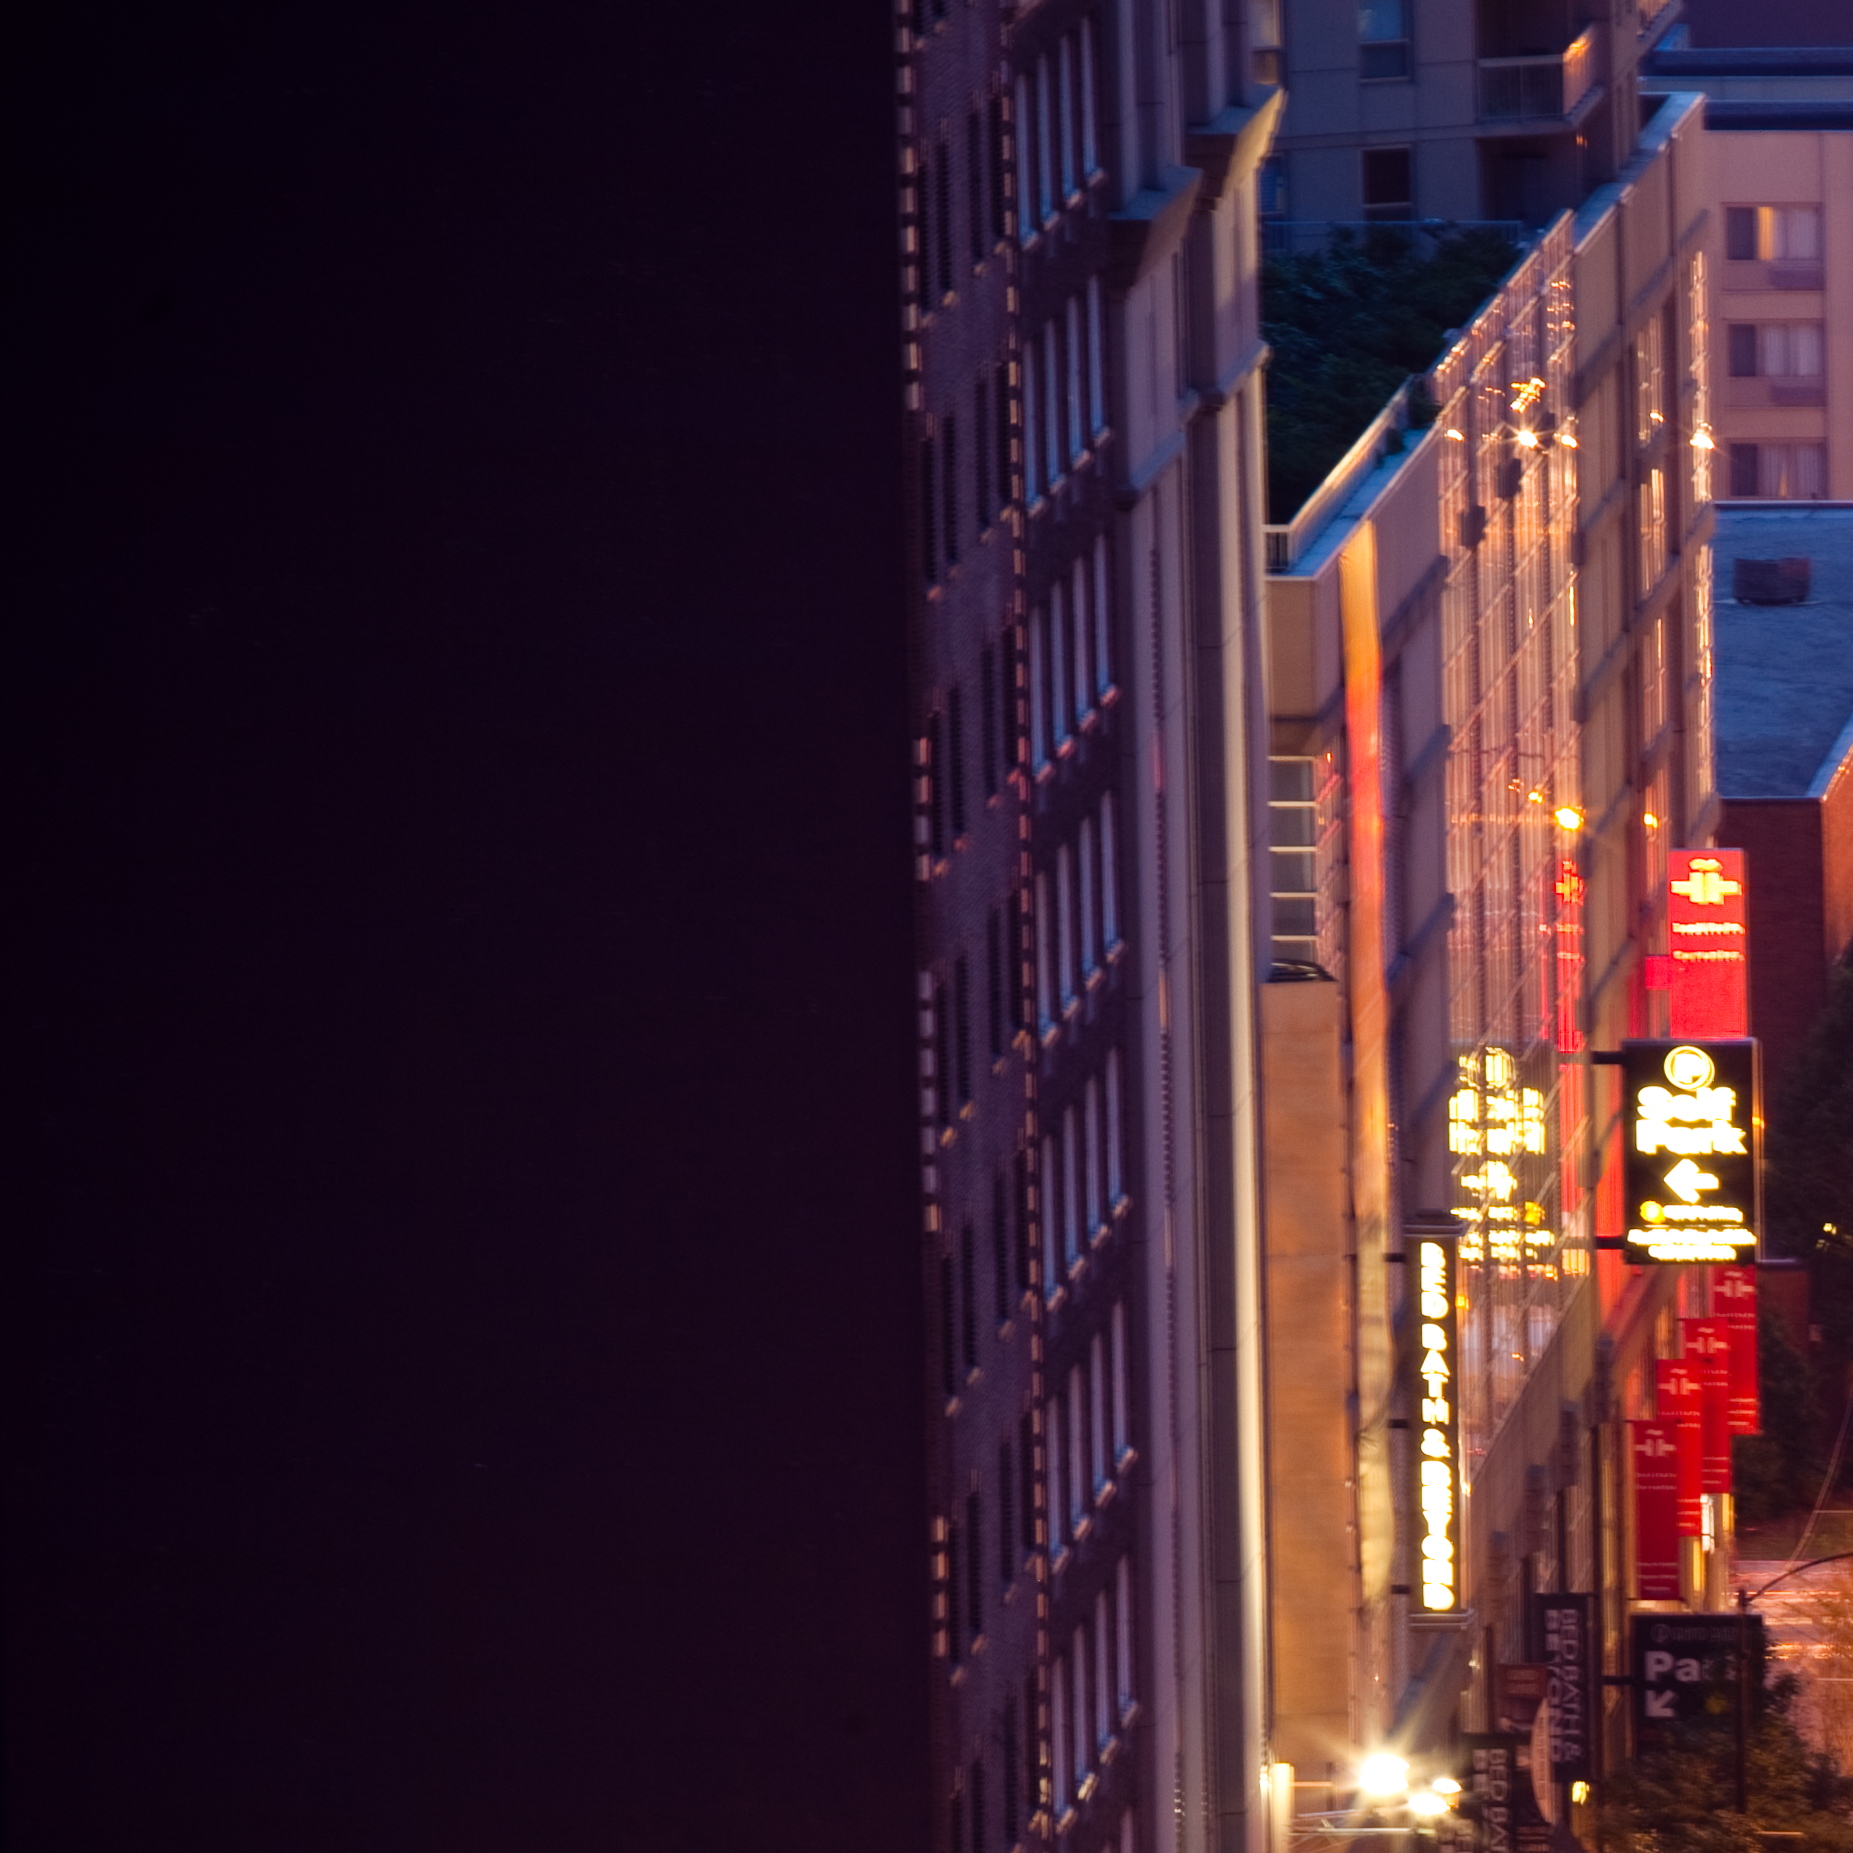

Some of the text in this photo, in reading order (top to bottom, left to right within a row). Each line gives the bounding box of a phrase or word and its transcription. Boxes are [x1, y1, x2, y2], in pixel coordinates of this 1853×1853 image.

[1420, 1242, 1449, 1319] BED
[1420, 1322, 1451, 1425] BATH
[1420, 1428, 1451, 1458] &
[1561, 1609, 1580, 1661] BED
[1562, 1666, 1582, 1736] BATH
[1490, 1749, 1508, 1802] BED
